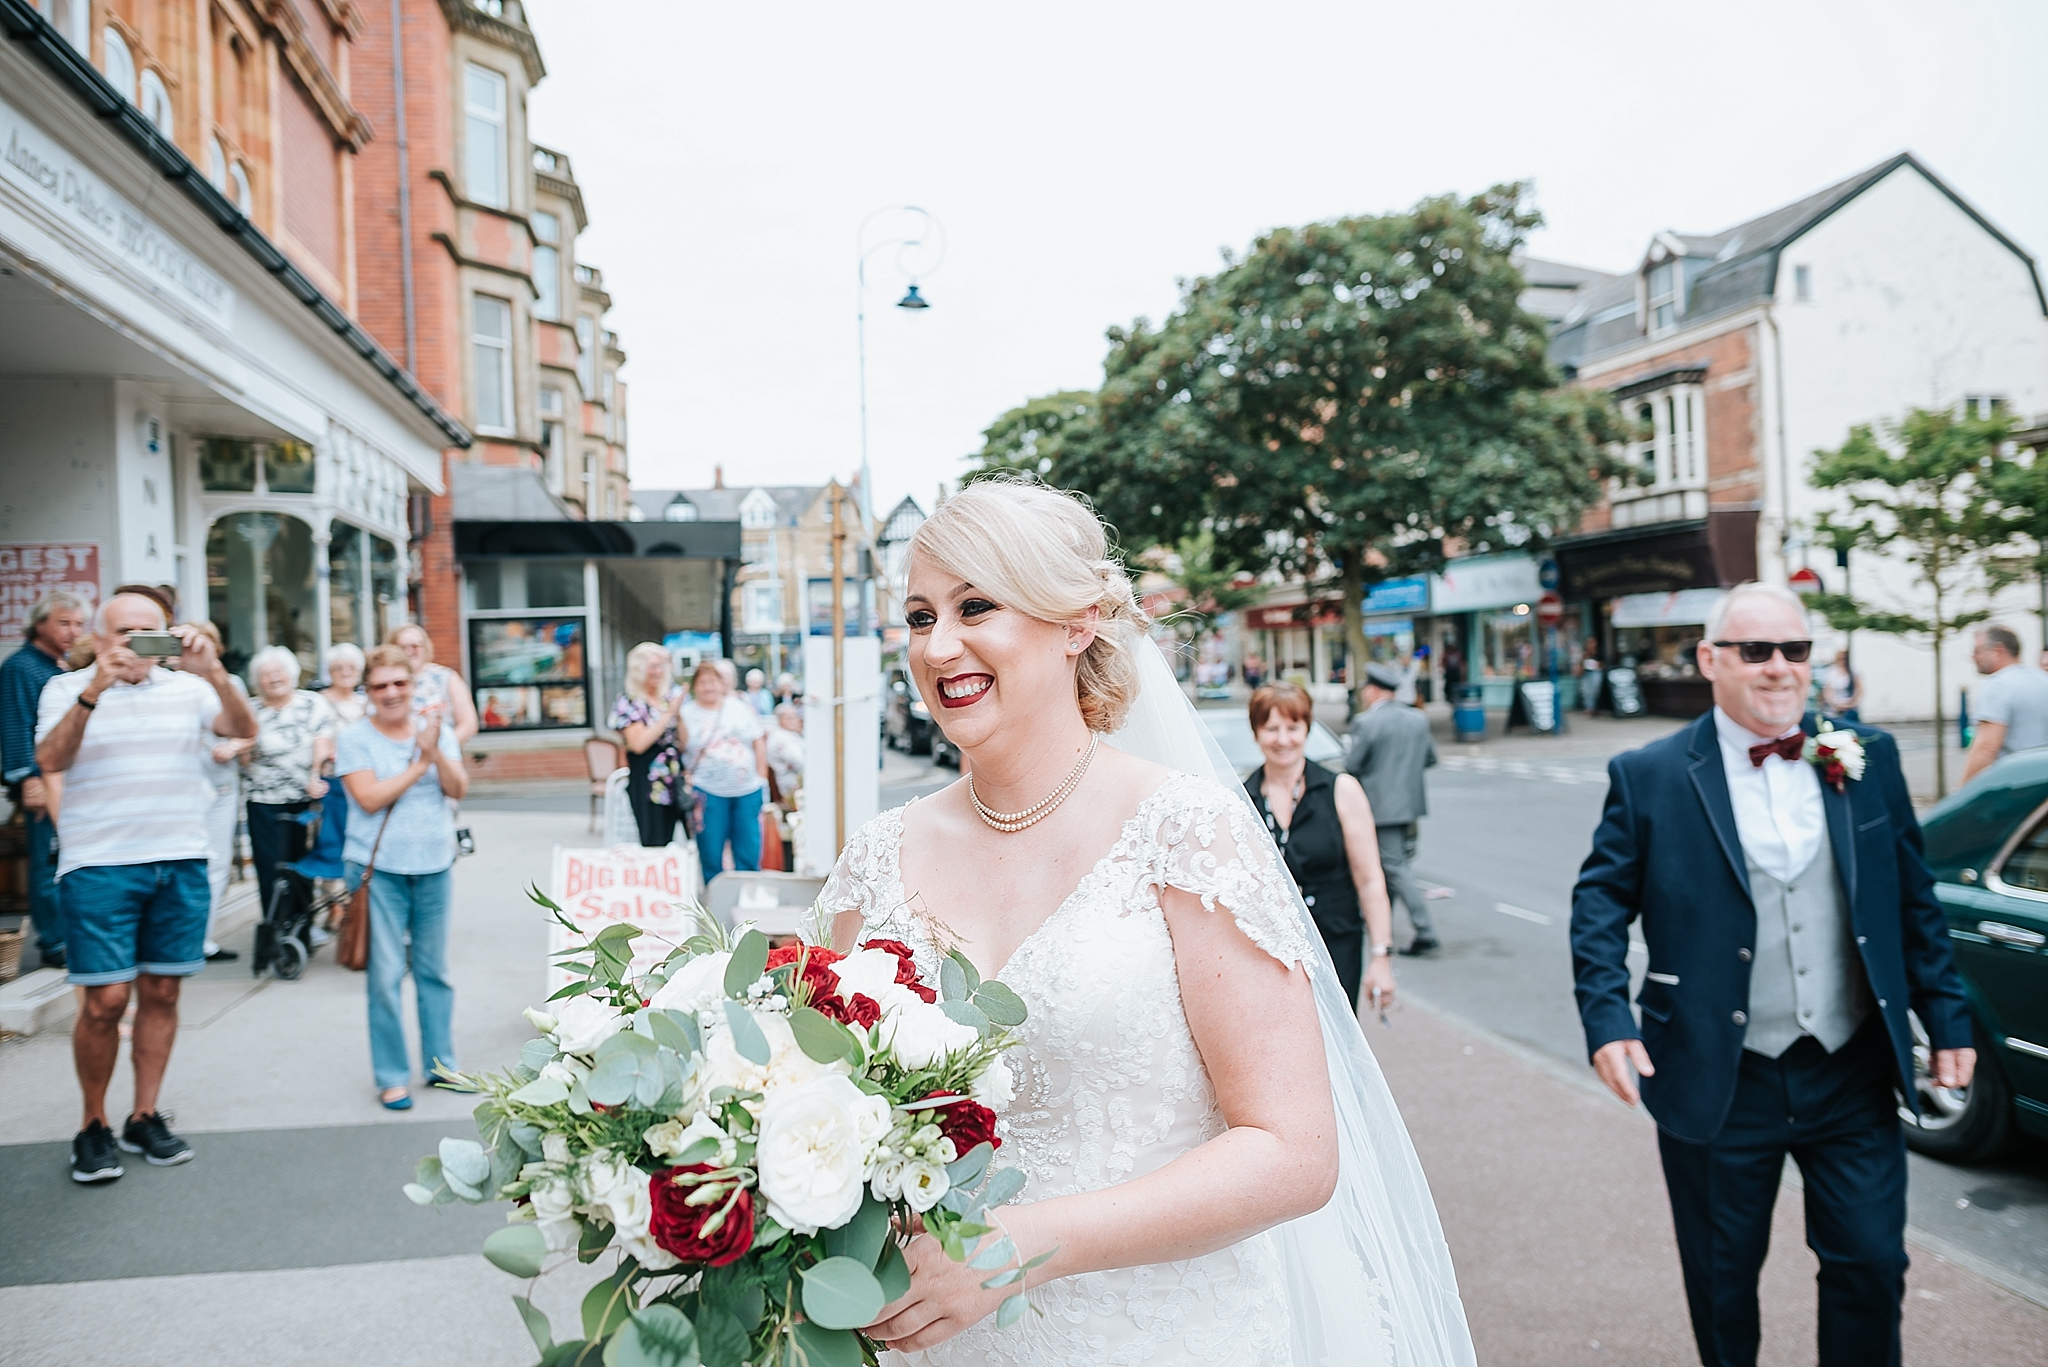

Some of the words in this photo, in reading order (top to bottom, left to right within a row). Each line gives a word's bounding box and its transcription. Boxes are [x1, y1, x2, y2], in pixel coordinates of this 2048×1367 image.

[565, 856, 614, 898] BIG
[623, 856, 682, 897] BAG
[574, 895, 674, 919] Sale
